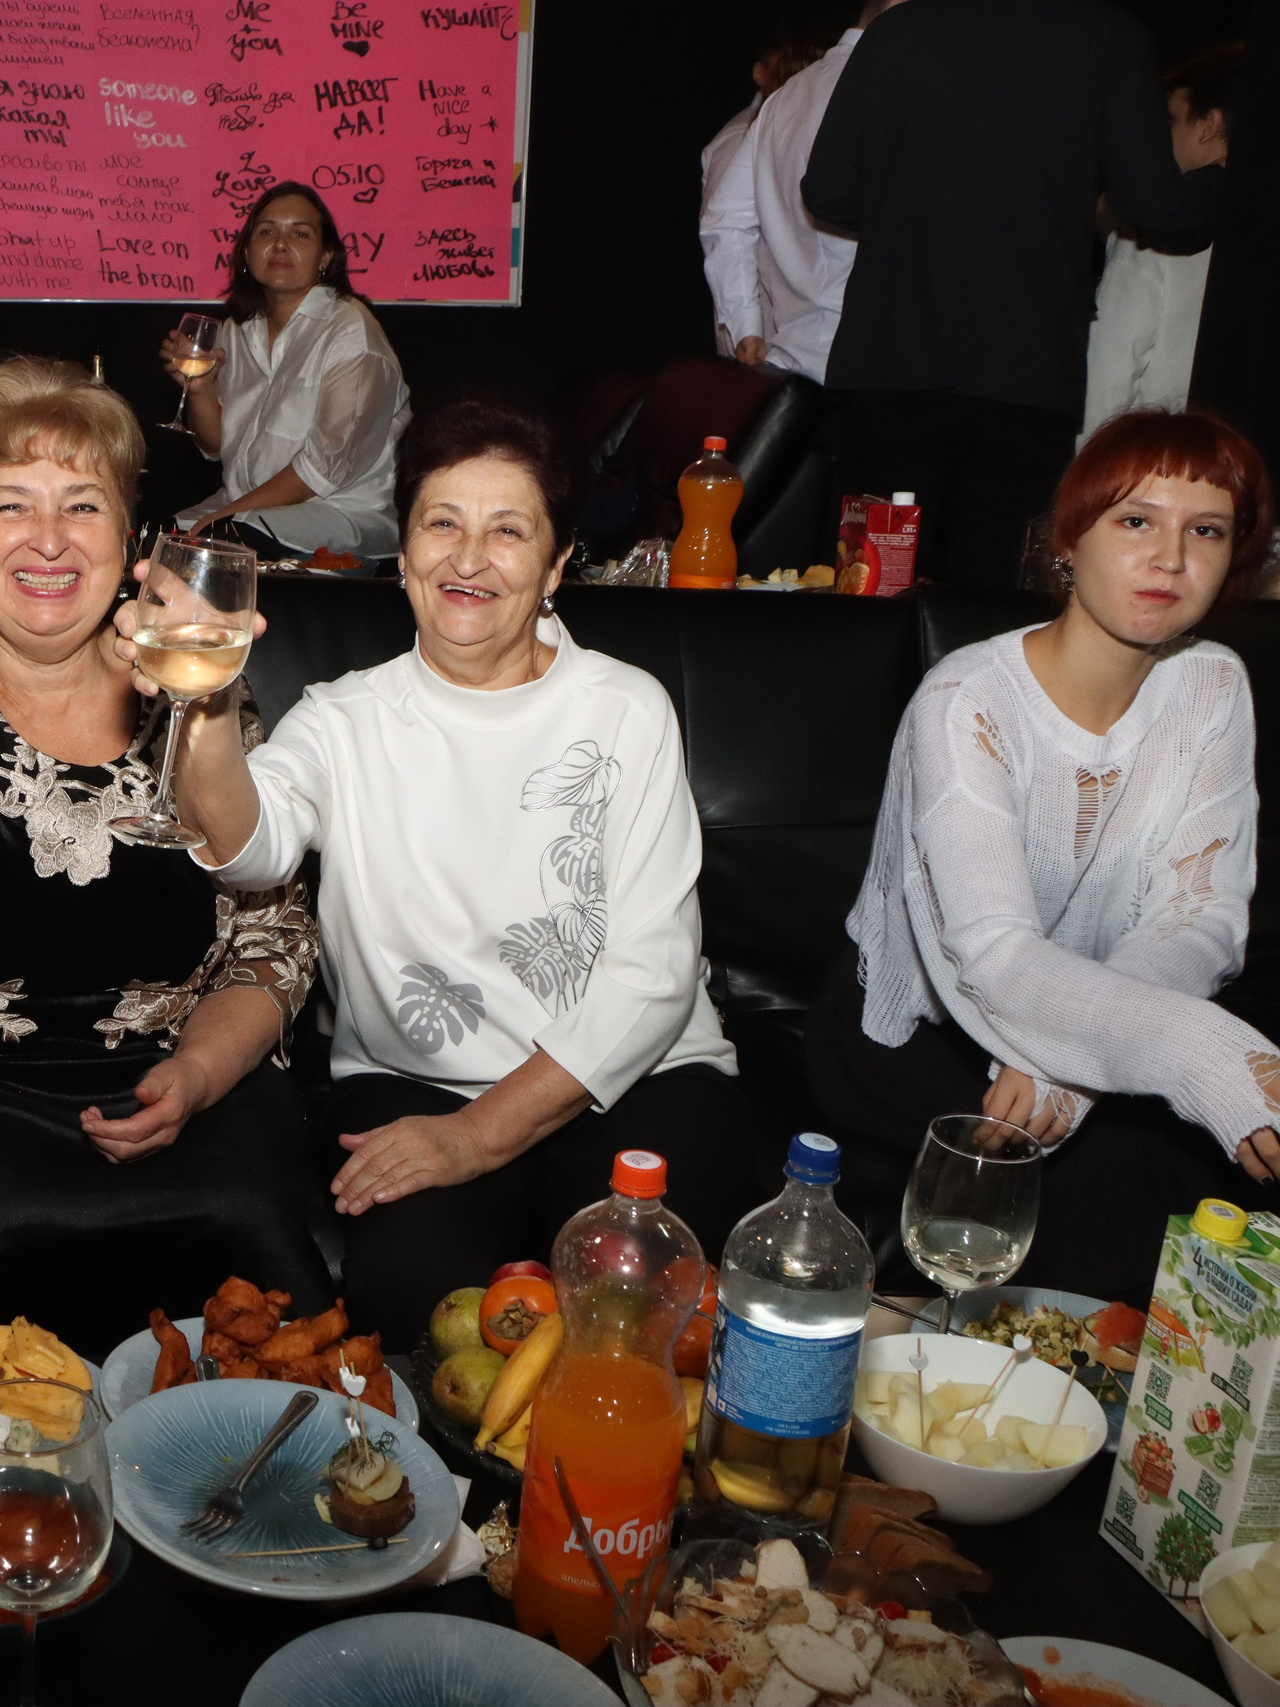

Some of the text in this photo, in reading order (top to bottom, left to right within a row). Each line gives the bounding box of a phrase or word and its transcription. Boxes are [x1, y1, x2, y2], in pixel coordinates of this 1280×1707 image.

[226, 0, 273, 22] Me
[331, 0, 369, 20] Be
[227, 33, 284, 62] you
[98, 77, 197, 105] someone
[419, 79, 493, 101] Have a
[104, 101, 156, 128] like
[333, 105, 385, 140] ДА!
[134, 131, 188, 149] you
[437, 117, 472, 145] day
[50, 236, 76, 252] up
[97, 229, 189, 259] Love on
[34, 252, 83, 271] dance
[99, 258, 195, 292] the brain
[46, 276, 73, 290] me
[1193, 1247, 1204, 1276] 4
